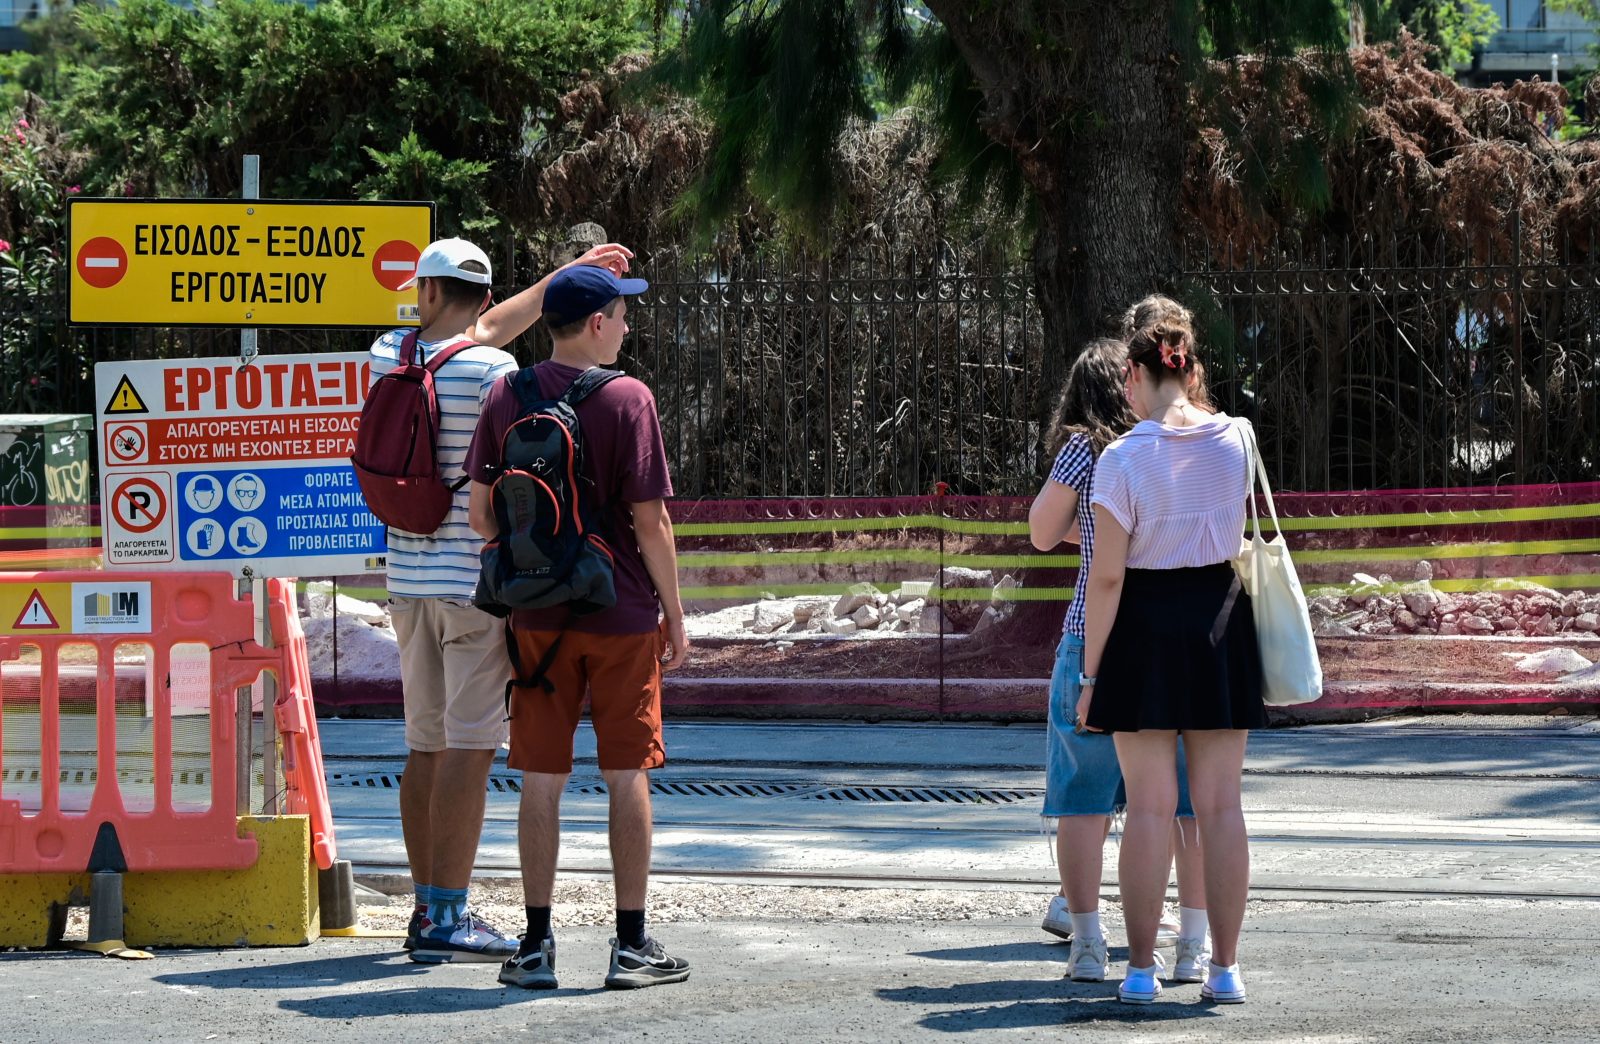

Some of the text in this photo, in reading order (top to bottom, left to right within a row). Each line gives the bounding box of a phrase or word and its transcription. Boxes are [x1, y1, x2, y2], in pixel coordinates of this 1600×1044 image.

[134, 224, 241, 256] ΕΙΣΟΔΟΣ
[267, 226, 366, 258] ΕΞΟΔΟΣ
[171, 272, 327, 304] ΕΡΓΟΤΑΞΙΟΥ
[166, 416, 361, 439] ΑΠΑΓΟΡΕΥΕΤΑΙ Η ΕΙΣΟΔΟ
[159, 438, 356, 461] ΣΤΟΥΣ ΜΗ ΕΧΟΝΤΕΣ ΕΡΓΑ
[304, 472, 353, 488] ΦΟΡΑΤΕ
[280, 492, 367, 509] ΜΕΣΑ ΑΤΟΜΙΚ
[277, 513, 348, 530] ΠΡΟΣΤΑΣΙΑΣ
[114, 540, 167, 548] ΑΠΑΓΟΡΕΥΕΤΑΙ
[289, 533, 373, 550] ΠΡΟΒΛΕΠΕΤΑΙ
[124, 549, 169, 557] ΠΑΡΚΑΡΙΣΜΑ
